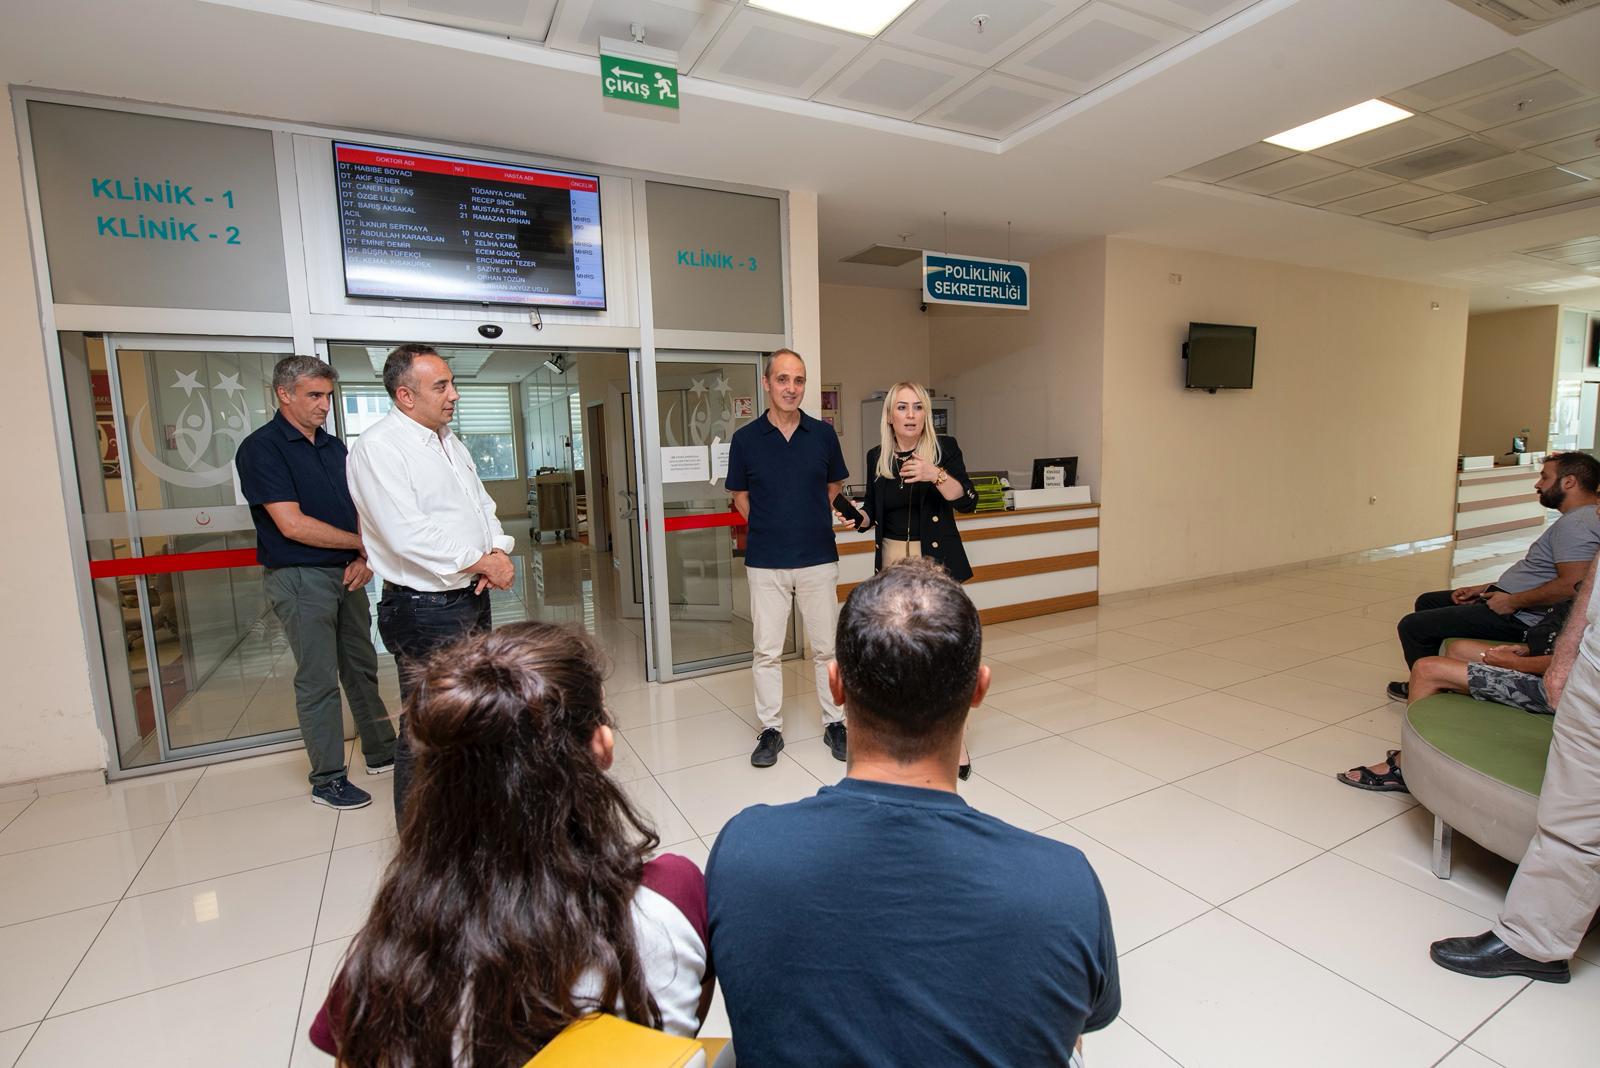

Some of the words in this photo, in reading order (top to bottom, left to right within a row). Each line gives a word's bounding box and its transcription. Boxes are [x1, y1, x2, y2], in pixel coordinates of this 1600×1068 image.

[605, 77, 650, 99] ÇIKIŞ
[376, 156, 403, 165] DOKTOR
[384, 168, 412, 177] BOYACI
[374, 176, 400, 185] ŞENER
[92, 177, 196, 206] KLİNİK
[222, 190, 234, 208] 1
[356, 184, 383, 192] CANER
[385, 186, 414, 197] BEKTAŞ
[357, 192, 378, 201] ÖZGE
[472, 196, 495, 204] RECEP
[383, 204, 416, 214] AKSAKAL
[472, 205, 504, 214] MUSTAFA
[472, 214, 506, 223] RAMAZAN
[507, 216, 531, 225] ORHAN
[96, 215, 200, 242] KLİNİK
[225, 226, 241, 244] 2
[389, 222, 428, 232] SERTKAYA
[360, 230, 400, 238] ABDULLAH
[402, 233, 445, 242] KARAASLAN
[476, 248, 495, 256] ECEM
[476, 257, 514, 266] ERCÜMENT
[677, 248, 734, 270] KLİNİK
[748, 256, 757, 272] 3
[945, 265, 1011, 284] POLİKLİNİK
[934, 281, 1021, 300] SEKRETERLİĞİ
